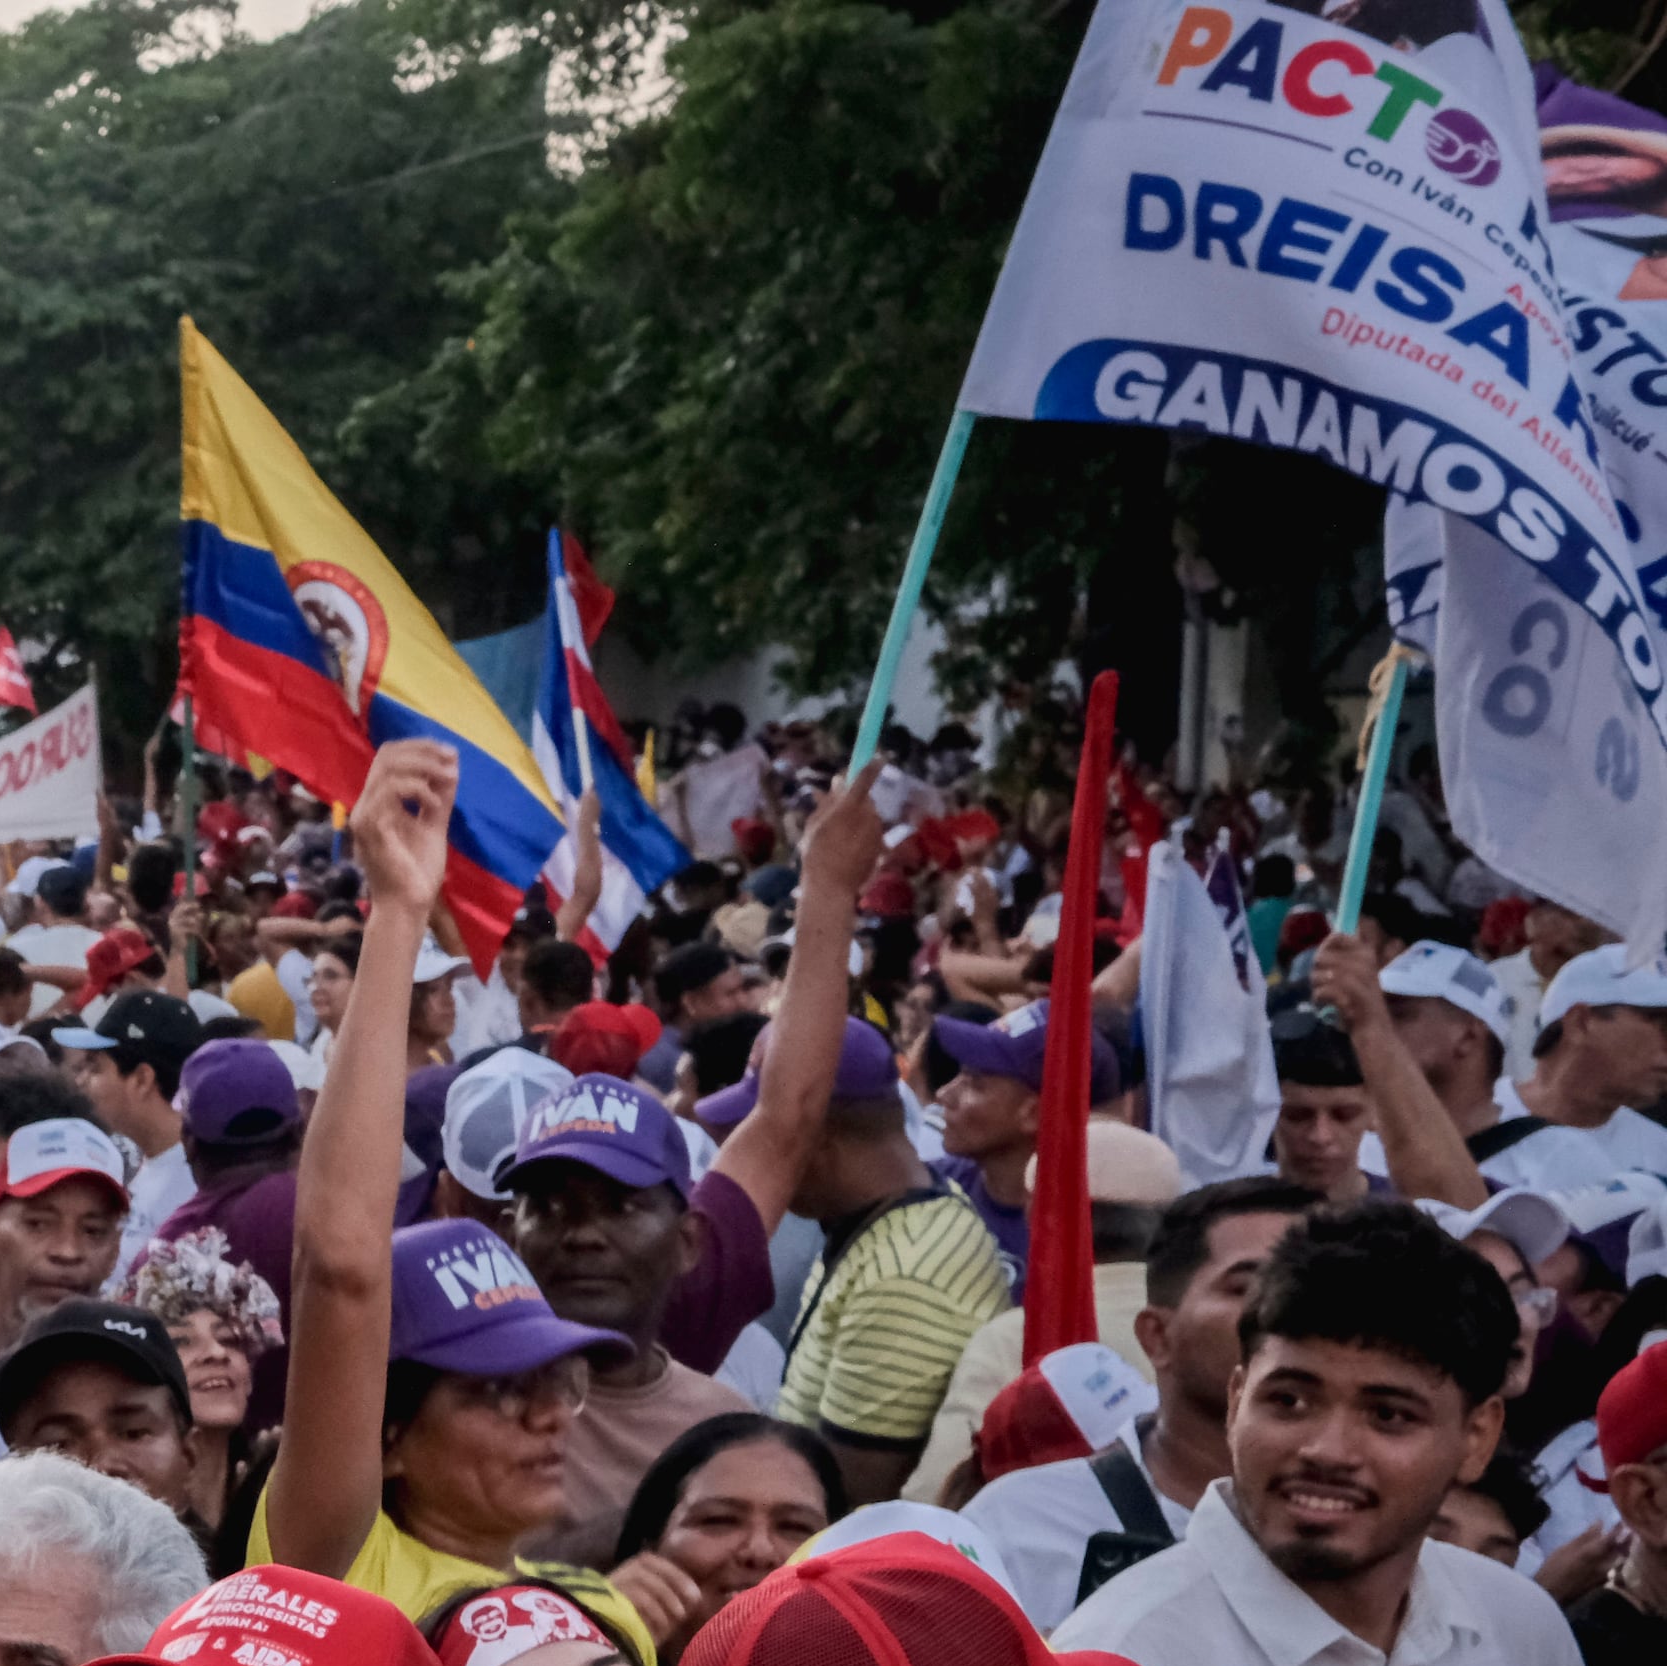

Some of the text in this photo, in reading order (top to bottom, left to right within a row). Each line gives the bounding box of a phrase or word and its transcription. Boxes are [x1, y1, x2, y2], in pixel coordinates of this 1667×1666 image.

[1344, 147, 1404, 186] Con
[1411, 176, 1474, 225] Iván
[1124, 172, 1530, 388] DREISA
[1320, 306, 1465, 384] Diputada
[1471, 378, 1519, 418] del
[1093, 350, 1566, 563] GANAMOS
[212, 1602, 327, 1639] PROGRESISTAS
